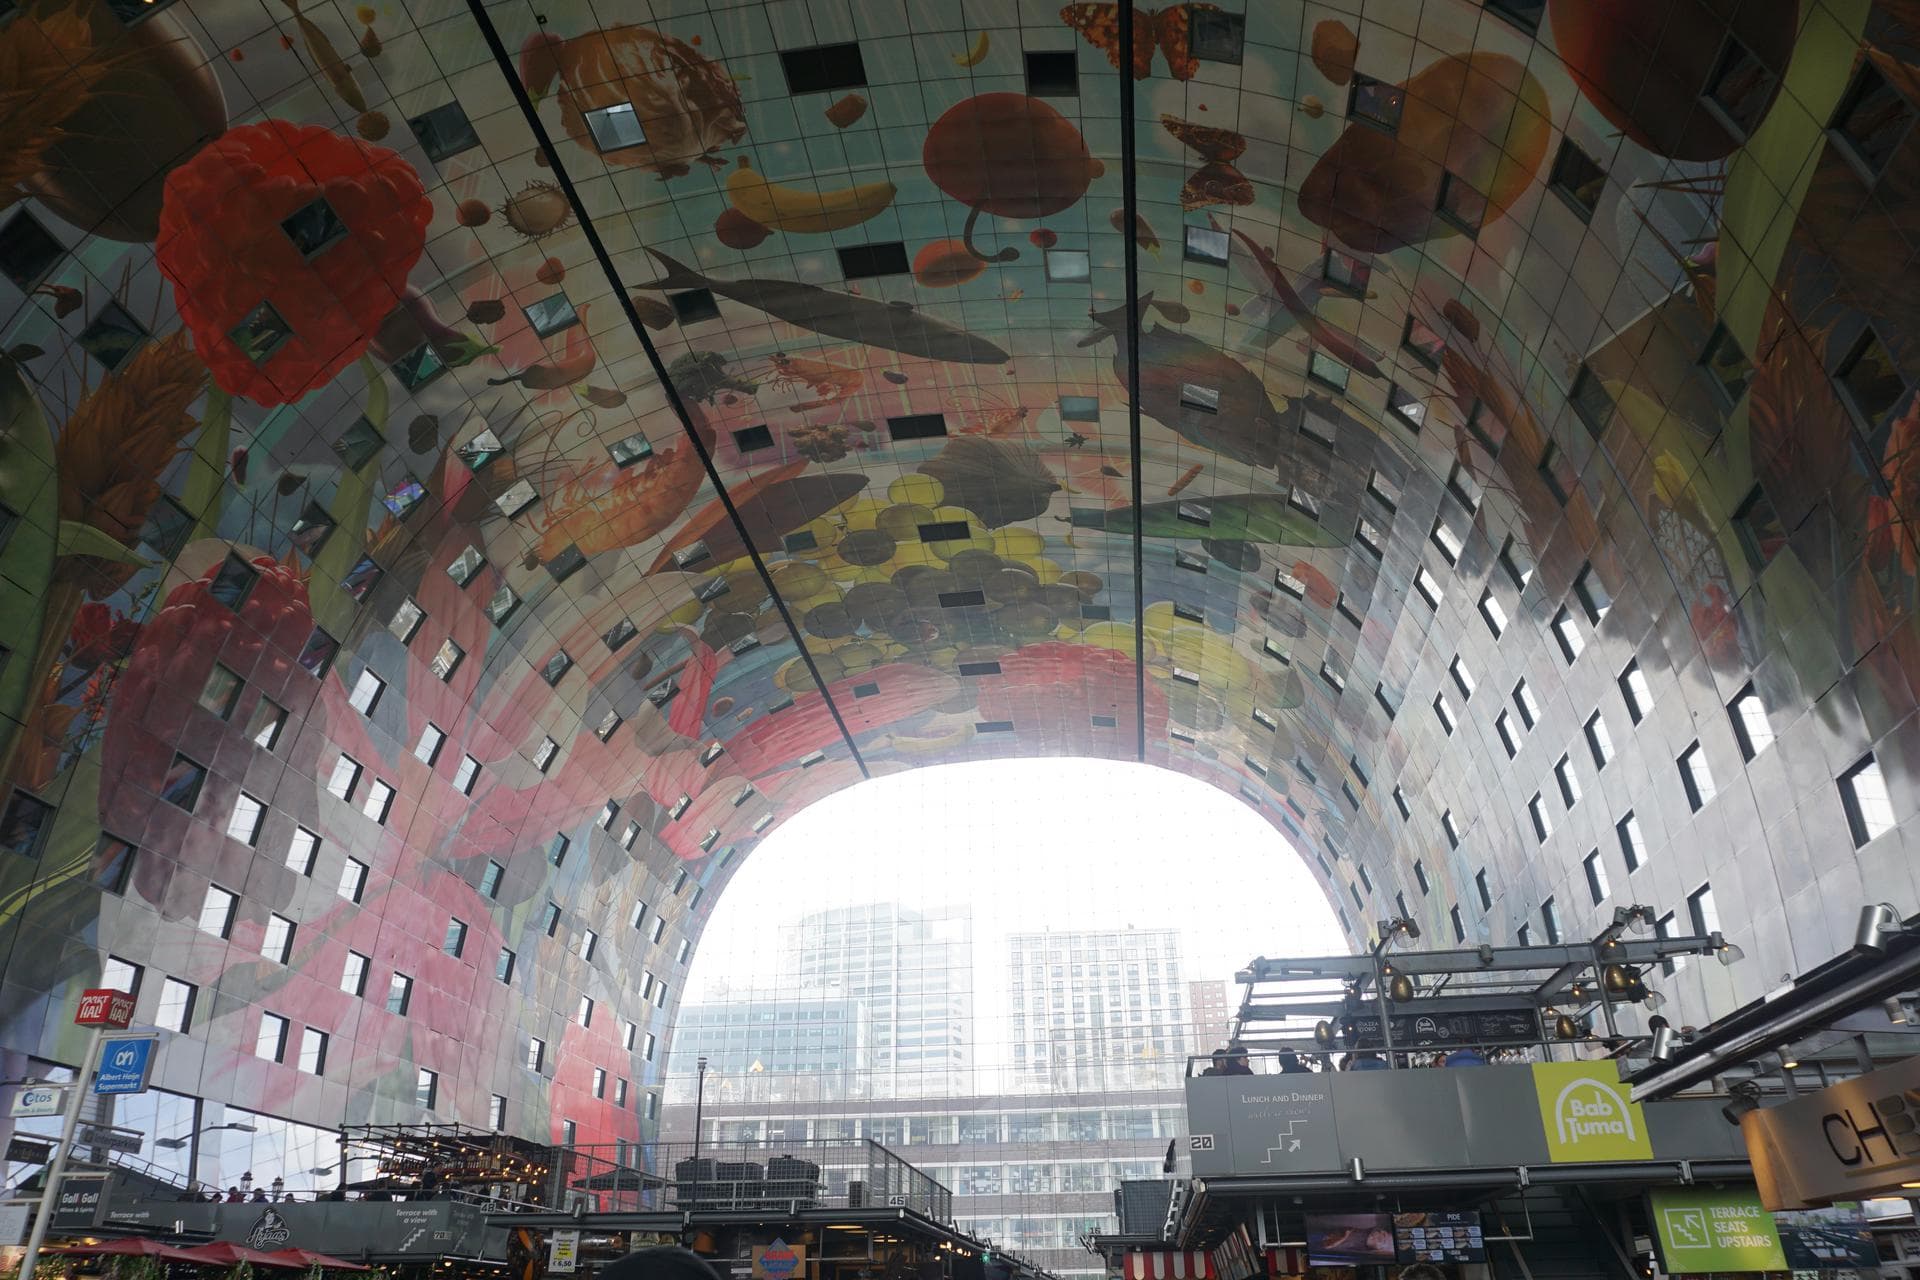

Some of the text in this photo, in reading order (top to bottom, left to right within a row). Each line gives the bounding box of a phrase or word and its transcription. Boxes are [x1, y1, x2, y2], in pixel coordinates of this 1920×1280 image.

[100, 1073, 122, 1081] Albert
[97, 1083, 138, 1091] Supermarkt
[1570, 1090, 1614, 1117] Bab
[1565, 1117, 1625, 1144] Tuma
[1190, 1136, 1213, 1149] 20
[62, 1193, 99, 1204] Gall Gall
[396, 1208, 439, 1217] Terrace with
[1710, 1206, 1761, 1219] TERRACE
[1714, 1221, 1749, 1233] SEATS
[1717, 1235, 1773, 1248] UPSTAIRS
